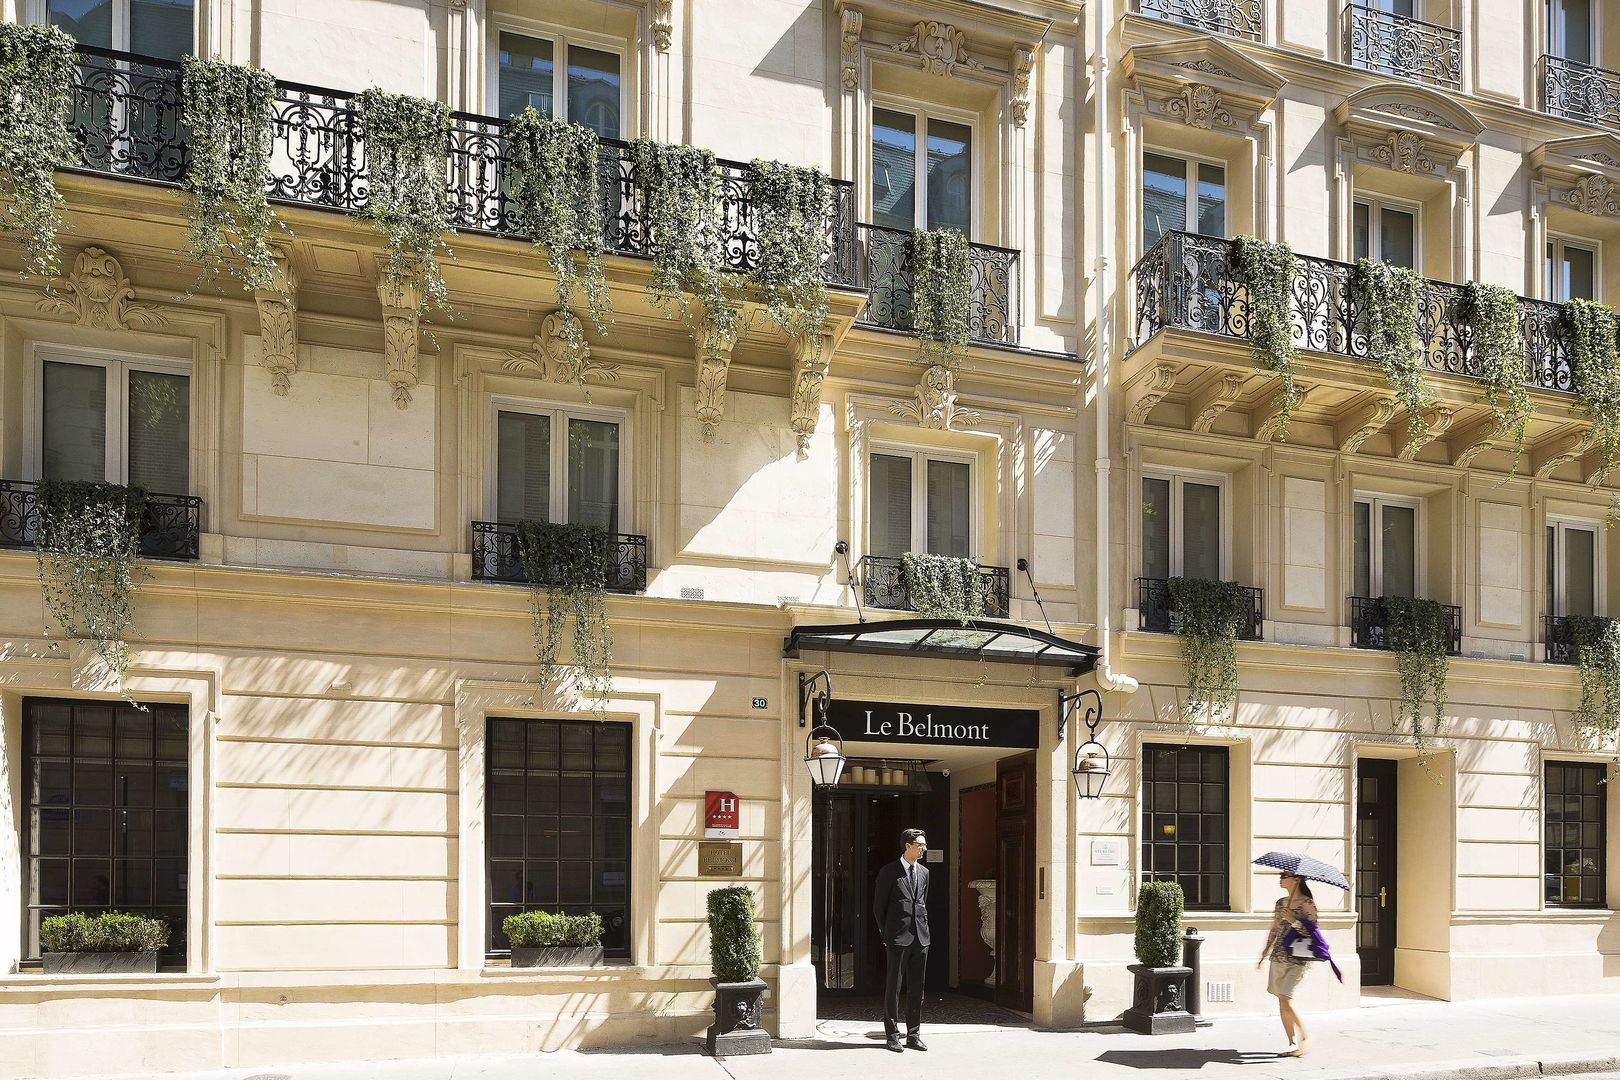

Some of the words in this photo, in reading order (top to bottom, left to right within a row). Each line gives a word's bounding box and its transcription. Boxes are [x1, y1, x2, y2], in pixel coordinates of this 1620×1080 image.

[754, 699, 766, 707] 30
[863, 710, 892, 736] Le
[896, 712, 990, 740] Belmont
[720, 798, 736, 812] H
